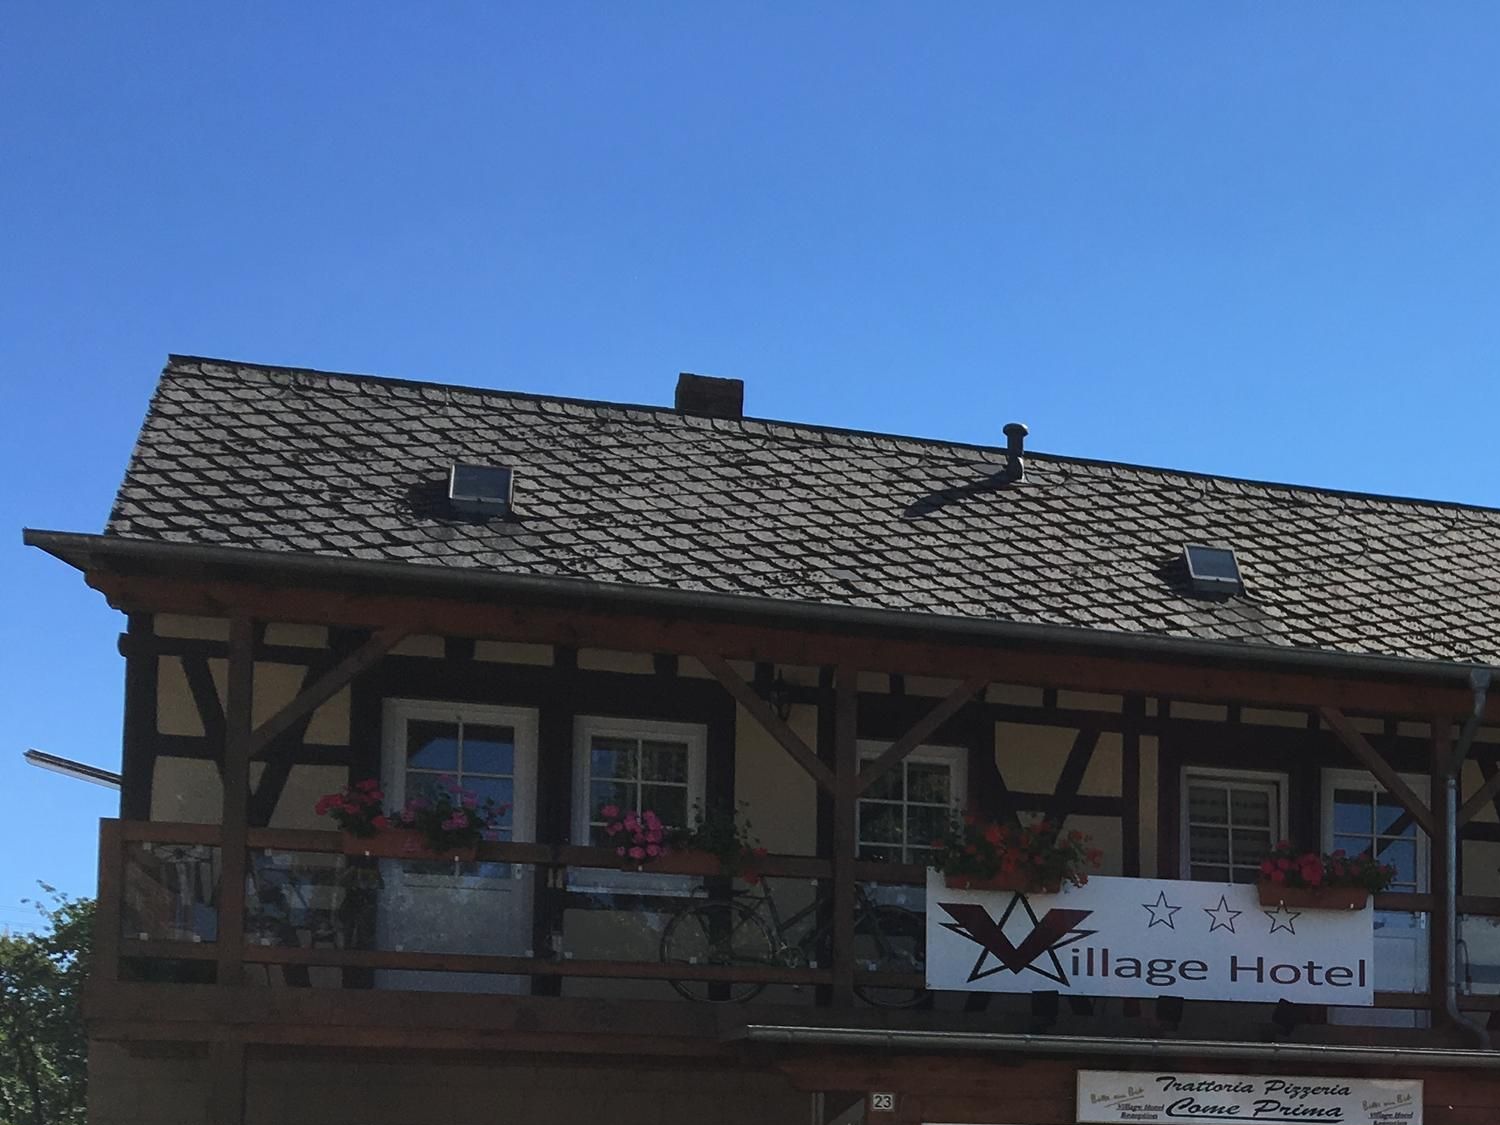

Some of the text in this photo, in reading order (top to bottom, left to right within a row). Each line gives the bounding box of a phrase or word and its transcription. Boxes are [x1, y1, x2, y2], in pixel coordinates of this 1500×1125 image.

[938, 901, 1366, 988] Village Hotel
[1156, 1076, 1351, 1099] Trattoria Pizzeria
[875, 1095, 892, 1108] 23
[1165, 1097, 1343, 1118] Come Prima
